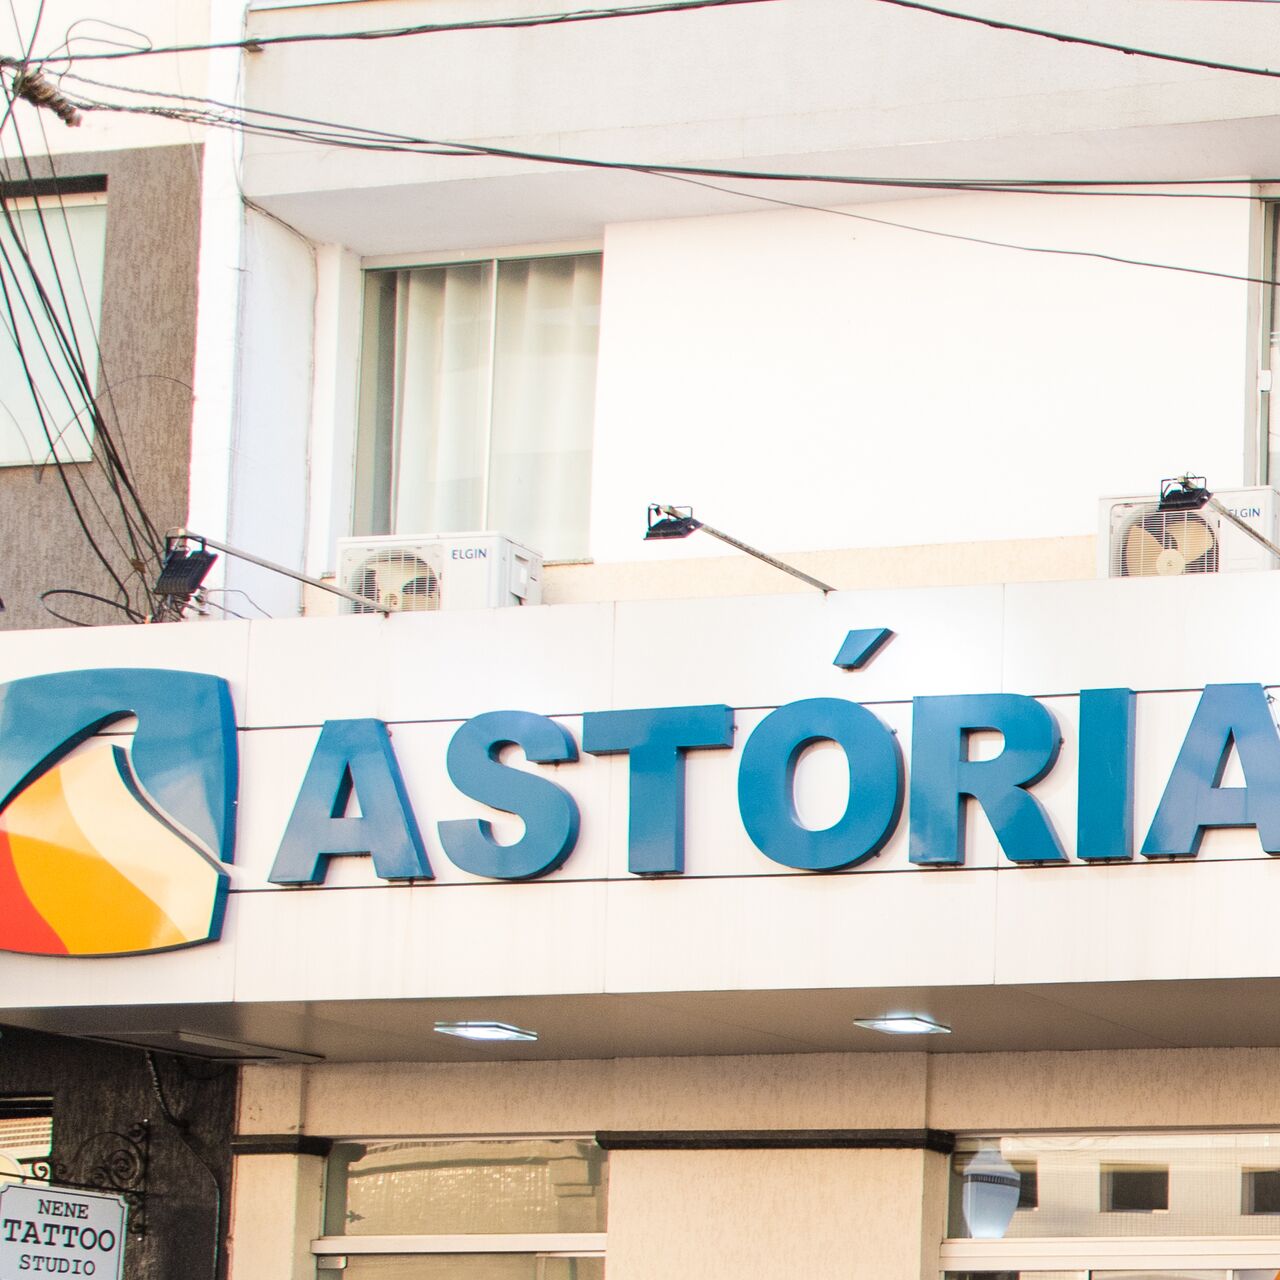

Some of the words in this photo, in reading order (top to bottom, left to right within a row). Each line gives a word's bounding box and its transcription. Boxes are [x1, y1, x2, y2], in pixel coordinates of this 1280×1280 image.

[452, 548, 487, 560] ELGIN
[38, 1199, 89, 1220] NENE
[3, 1218, 116, 1252] TATTOO
[19, 1254, 96, 1276] STUDIO
